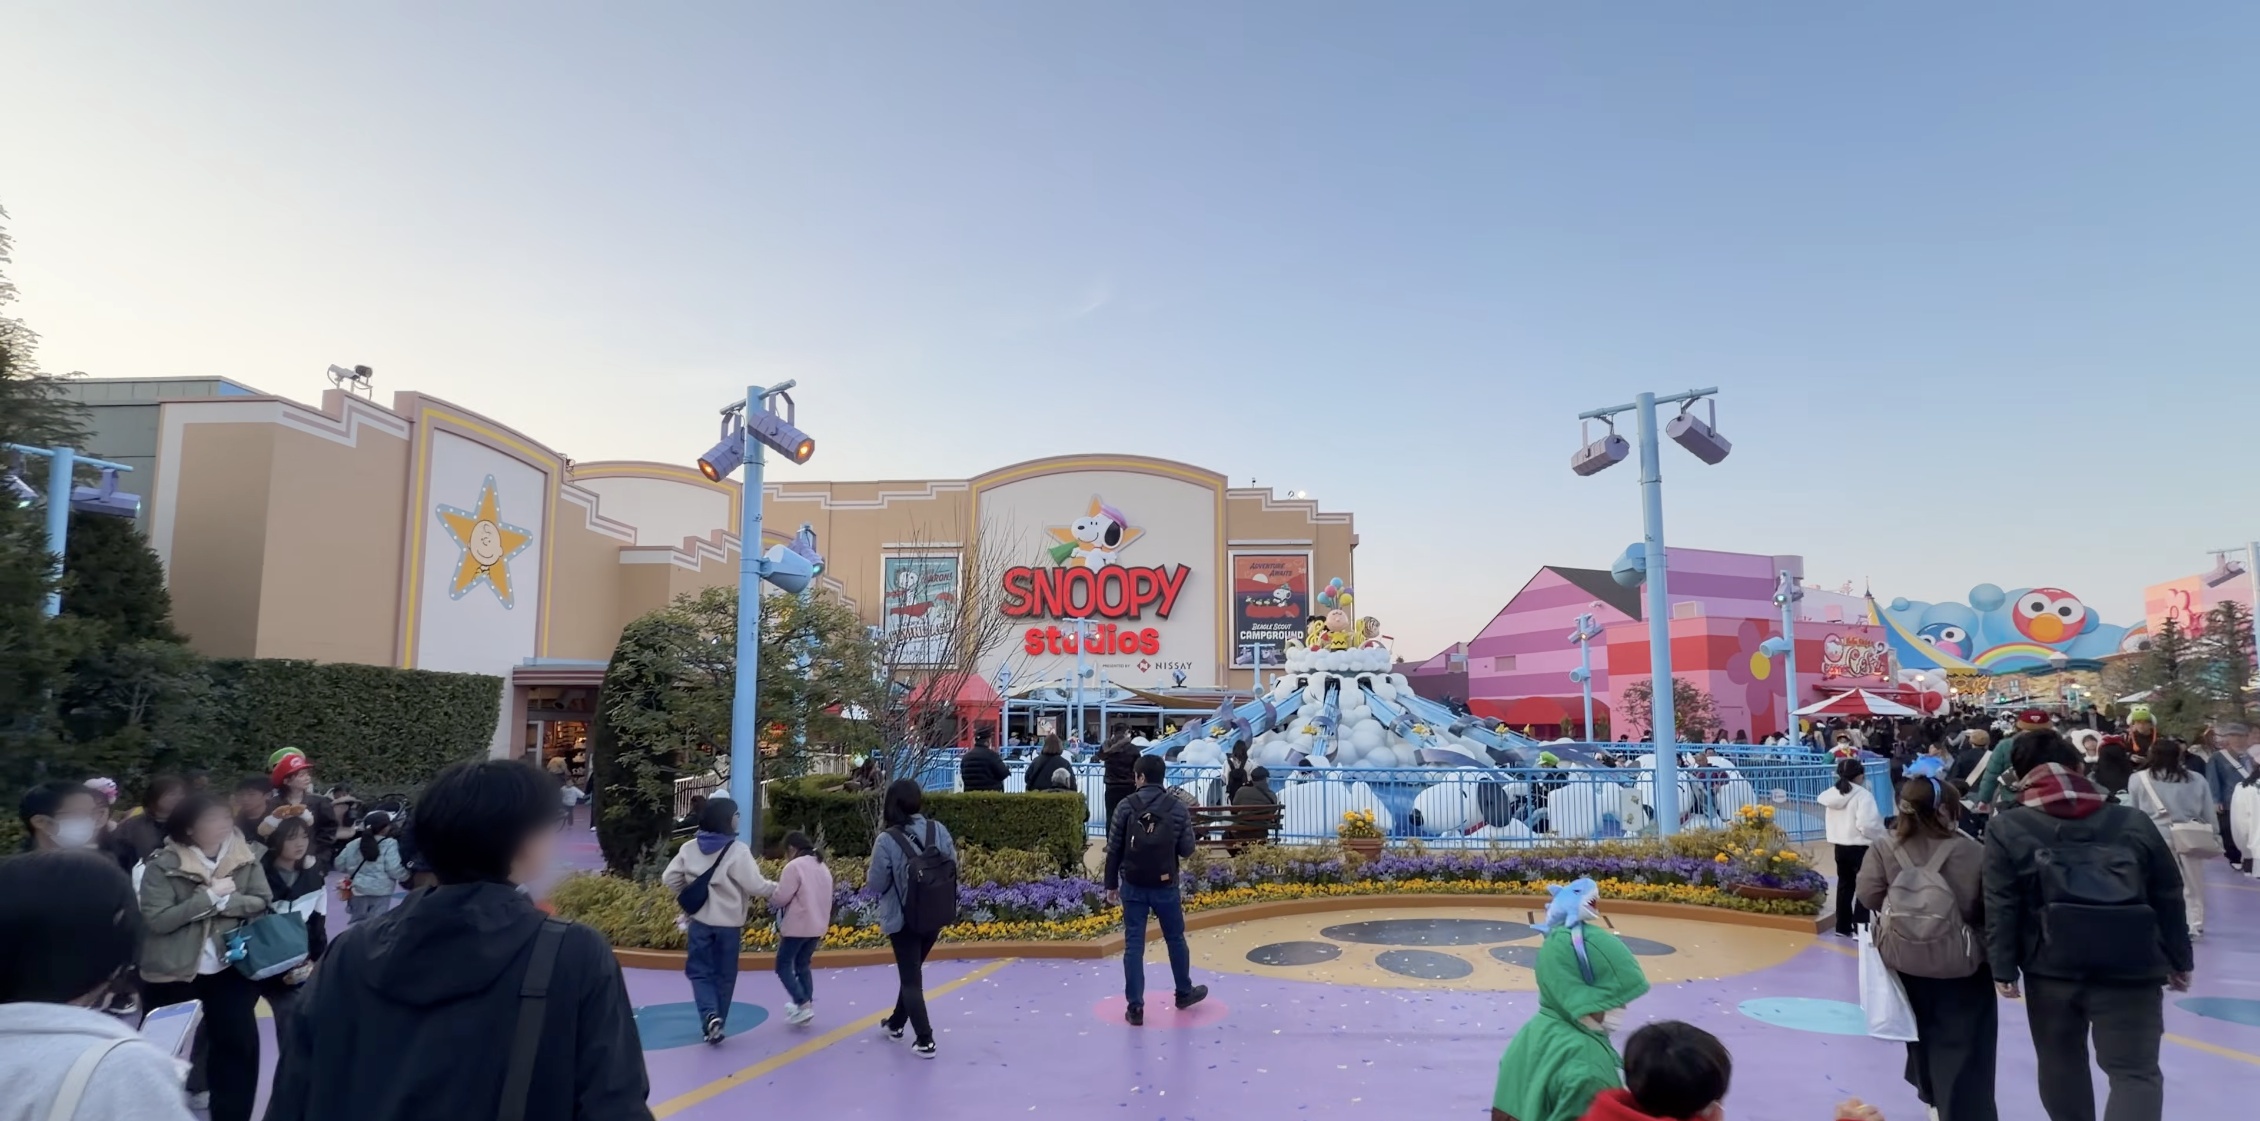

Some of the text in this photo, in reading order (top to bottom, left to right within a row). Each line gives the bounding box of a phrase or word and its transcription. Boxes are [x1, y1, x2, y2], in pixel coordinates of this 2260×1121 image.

[1002, 563, 1191, 620] SNOOPY
[1240, 630, 1304, 640] CAMPGROUND
[1155, 661, 1192, 670] NISSAY
